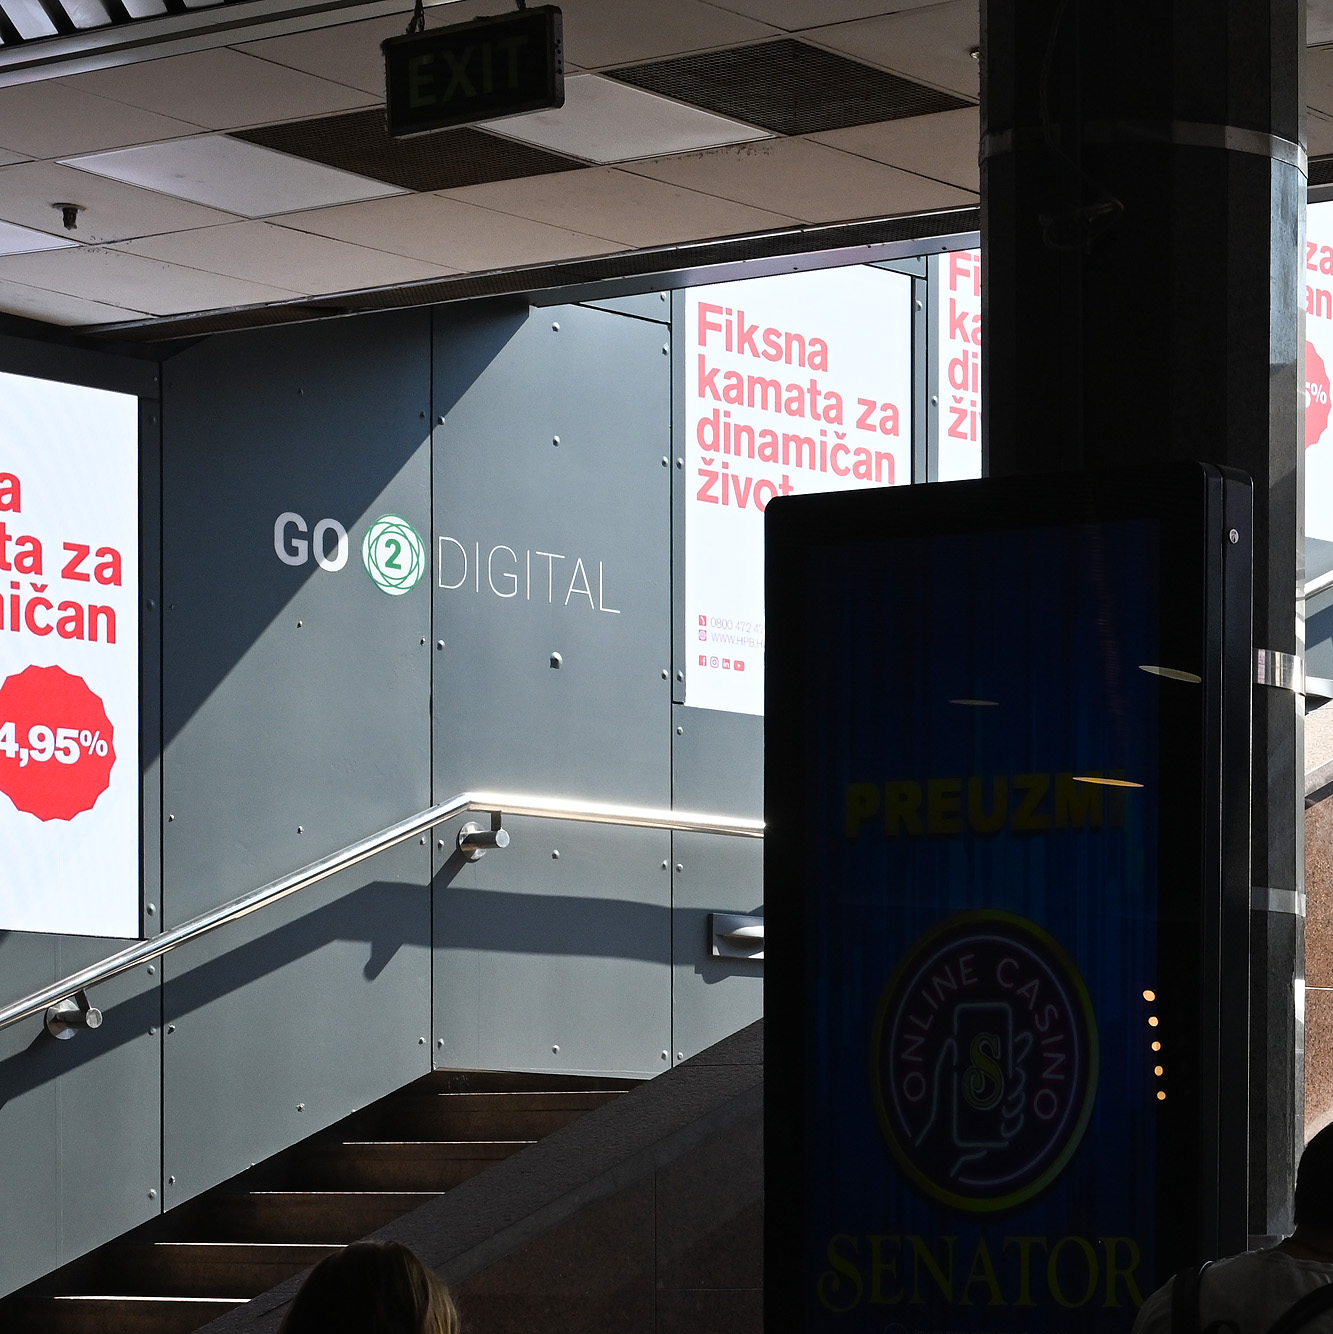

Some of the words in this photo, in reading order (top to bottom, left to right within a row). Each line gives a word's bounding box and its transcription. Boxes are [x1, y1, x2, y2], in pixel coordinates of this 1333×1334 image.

[407, 33, 529, 109] EXIT
[949, 250, 982, 297] Fi
[697, 301, 828, 373] Fiksna
[697, 353, 843, 426] kamata
[855, 397, 900, 437] za
[947, 394, 982, 442] ži
[696, 408, 895, 485] dinamičan
[61, 541, 123, 587] za
[273, 511, 349, 573] GO
[438, 535, 621, 614] DIGITAL
[0, 580, 117, 645] ičan
[710, 616, 733, 630] 0800
[734, 620, 752, 634] 472
[753, 623, 764, 635] 47
[710, 632, 763, 649] WWW.HPB.H
[0, 721, 109, 768] 4,95%
[844, 768, 1127, 838] PREUZMI
[901, 953, 979, 1102] ONLINE
[996, 957, 1068, 1121] CASINO
[816, 1232, 1148, 1313] SENATOR
